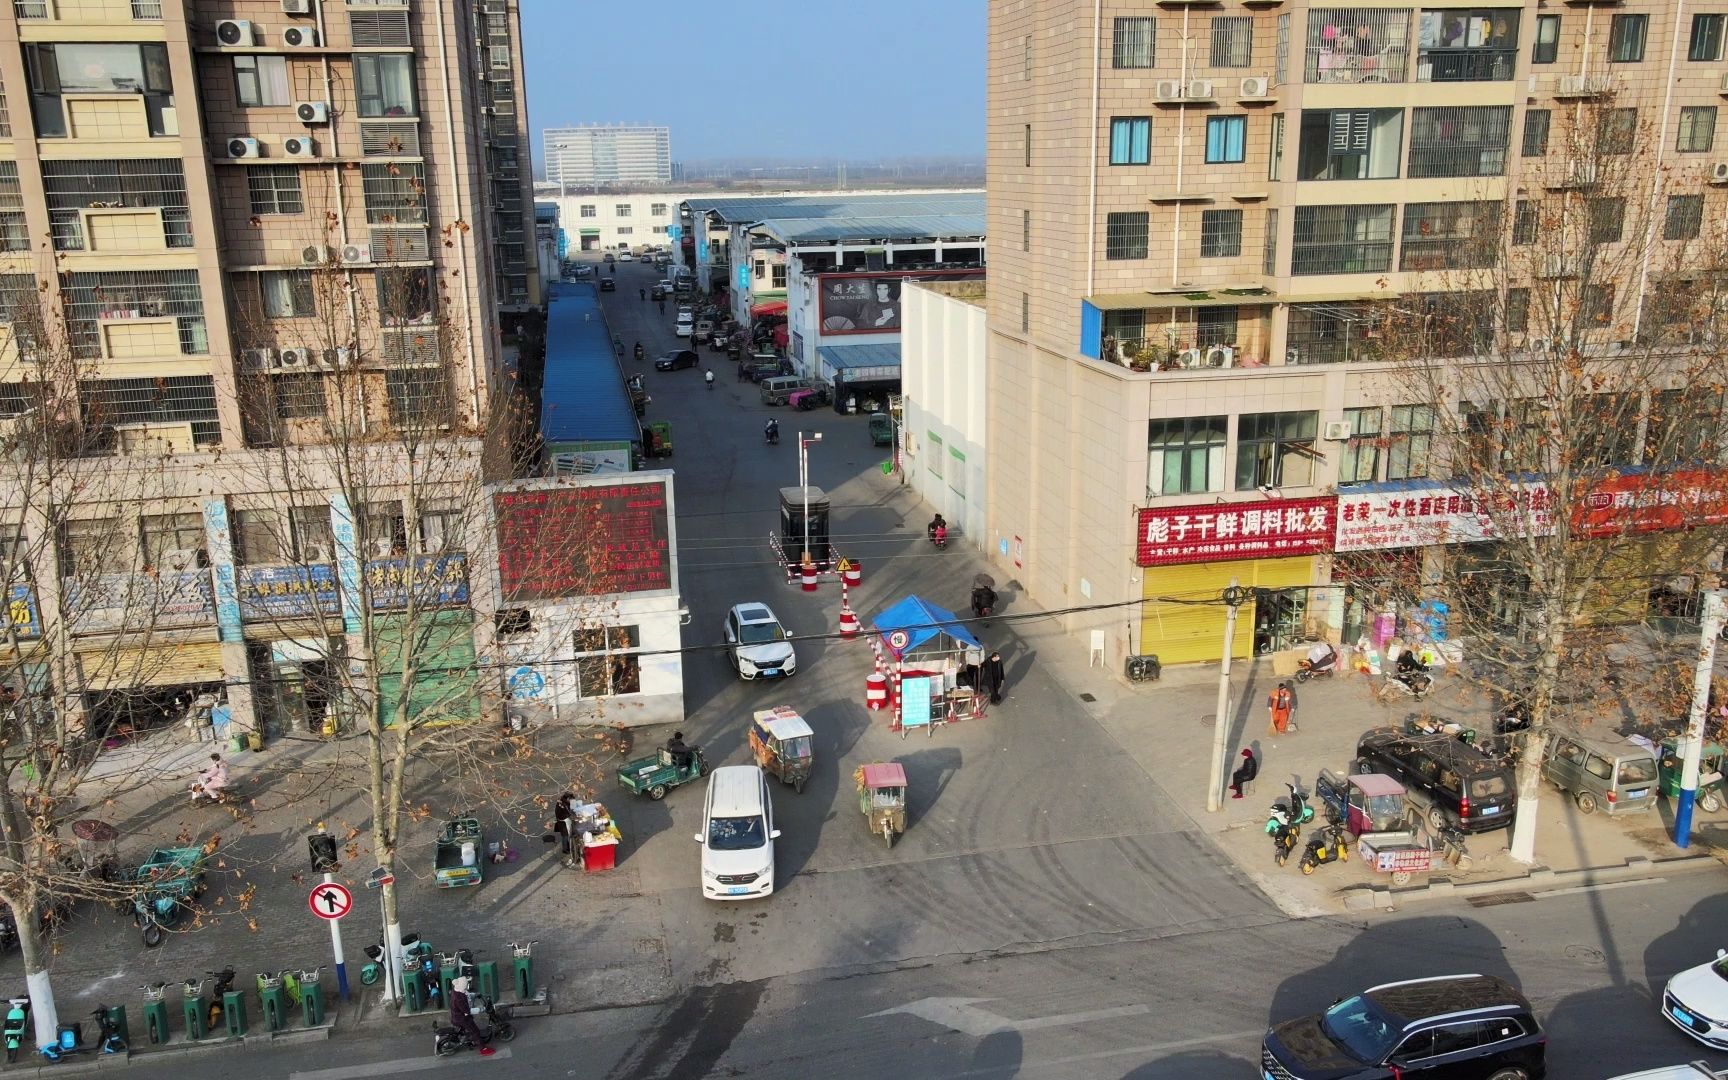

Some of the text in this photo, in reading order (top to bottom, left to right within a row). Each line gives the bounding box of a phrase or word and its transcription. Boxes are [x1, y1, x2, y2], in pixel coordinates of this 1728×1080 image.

[833, 283, 866, 294] 周大生
[1147, 505, 1328, 543] 彪子干鲜调料批发
